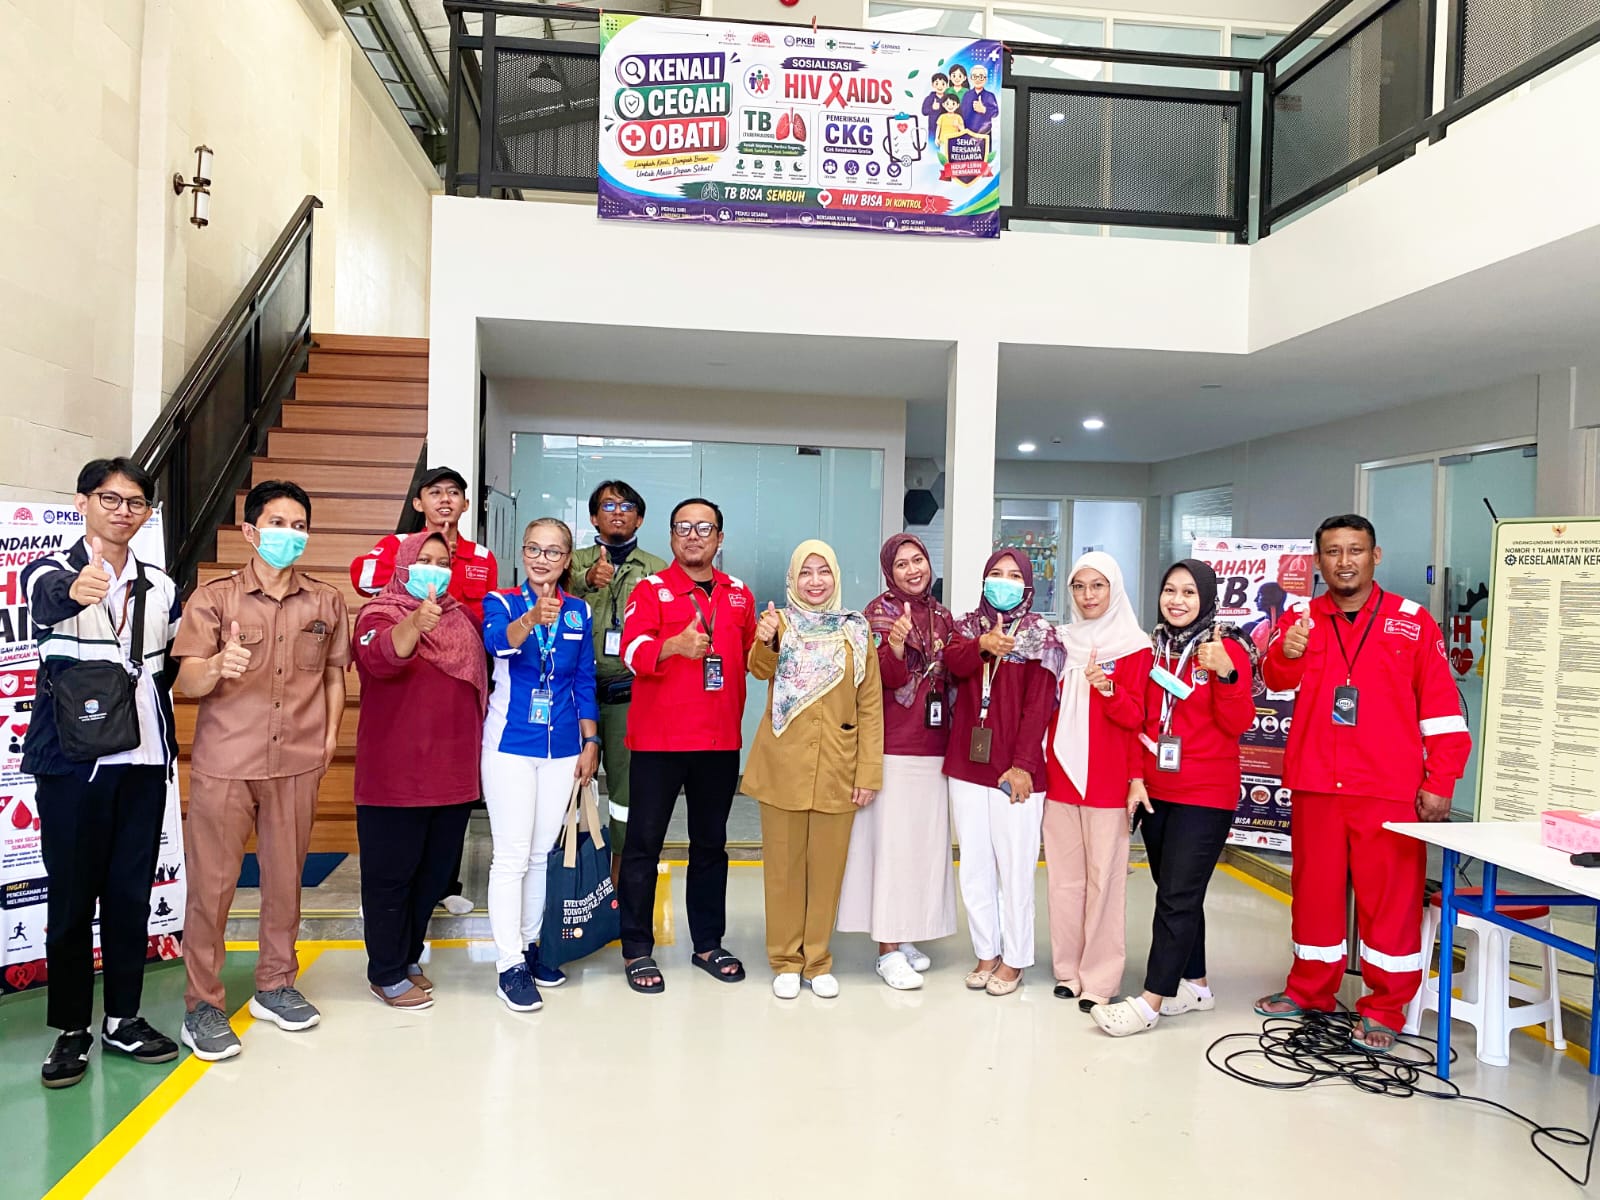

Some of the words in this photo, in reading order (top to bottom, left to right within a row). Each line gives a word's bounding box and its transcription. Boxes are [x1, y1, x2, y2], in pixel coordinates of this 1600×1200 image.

[796, 37, 815, 45] PKBI
[648, 57, 720, 82] KENALI
[792, 58, 852, 71] SOSIALISASI
[784, 73, 823, 100] HIV
[847, 77, 893, 105] AIDS
[648, 87, 726, 116] CEGAH
[744, 110, 771, 132] TB
[826, 115, 870, 123] PEMERIKSAAN
[650, 121, 720, 151] OBATI
[825, 123, 873, 146] CKG
[636, 169, 655, 178] Untuk
[656, 169, 672, 177] Masa
[674, 167, 691, 176] Depan
[693, 164, 714, 173] Sehat!
[725, 187, 737, 199] TB
[740, 188, 762, 200] BISA
[766, 189, 805, 203] SEMBUH
[842, 193, 859, 206] HIV
[860, 194, 882, 207] BISA
[885, 199, 892, 207] DI
[894, 199, 921, 209] KONTROL
[56, 511, 83, 521] PKBI
[0, 534, 63, 551] NDAKAN
[1518, 555, 1581, 565] KESELAMATAN
[1453, 615, 1472, 643] H
[1235, 816, 1250, 825] BISA
[1251, 818, 1275, 827] AKHIRI
[1277, 820, 1290, 828] TB!
[6, 882, 29, 891] INGAT!
